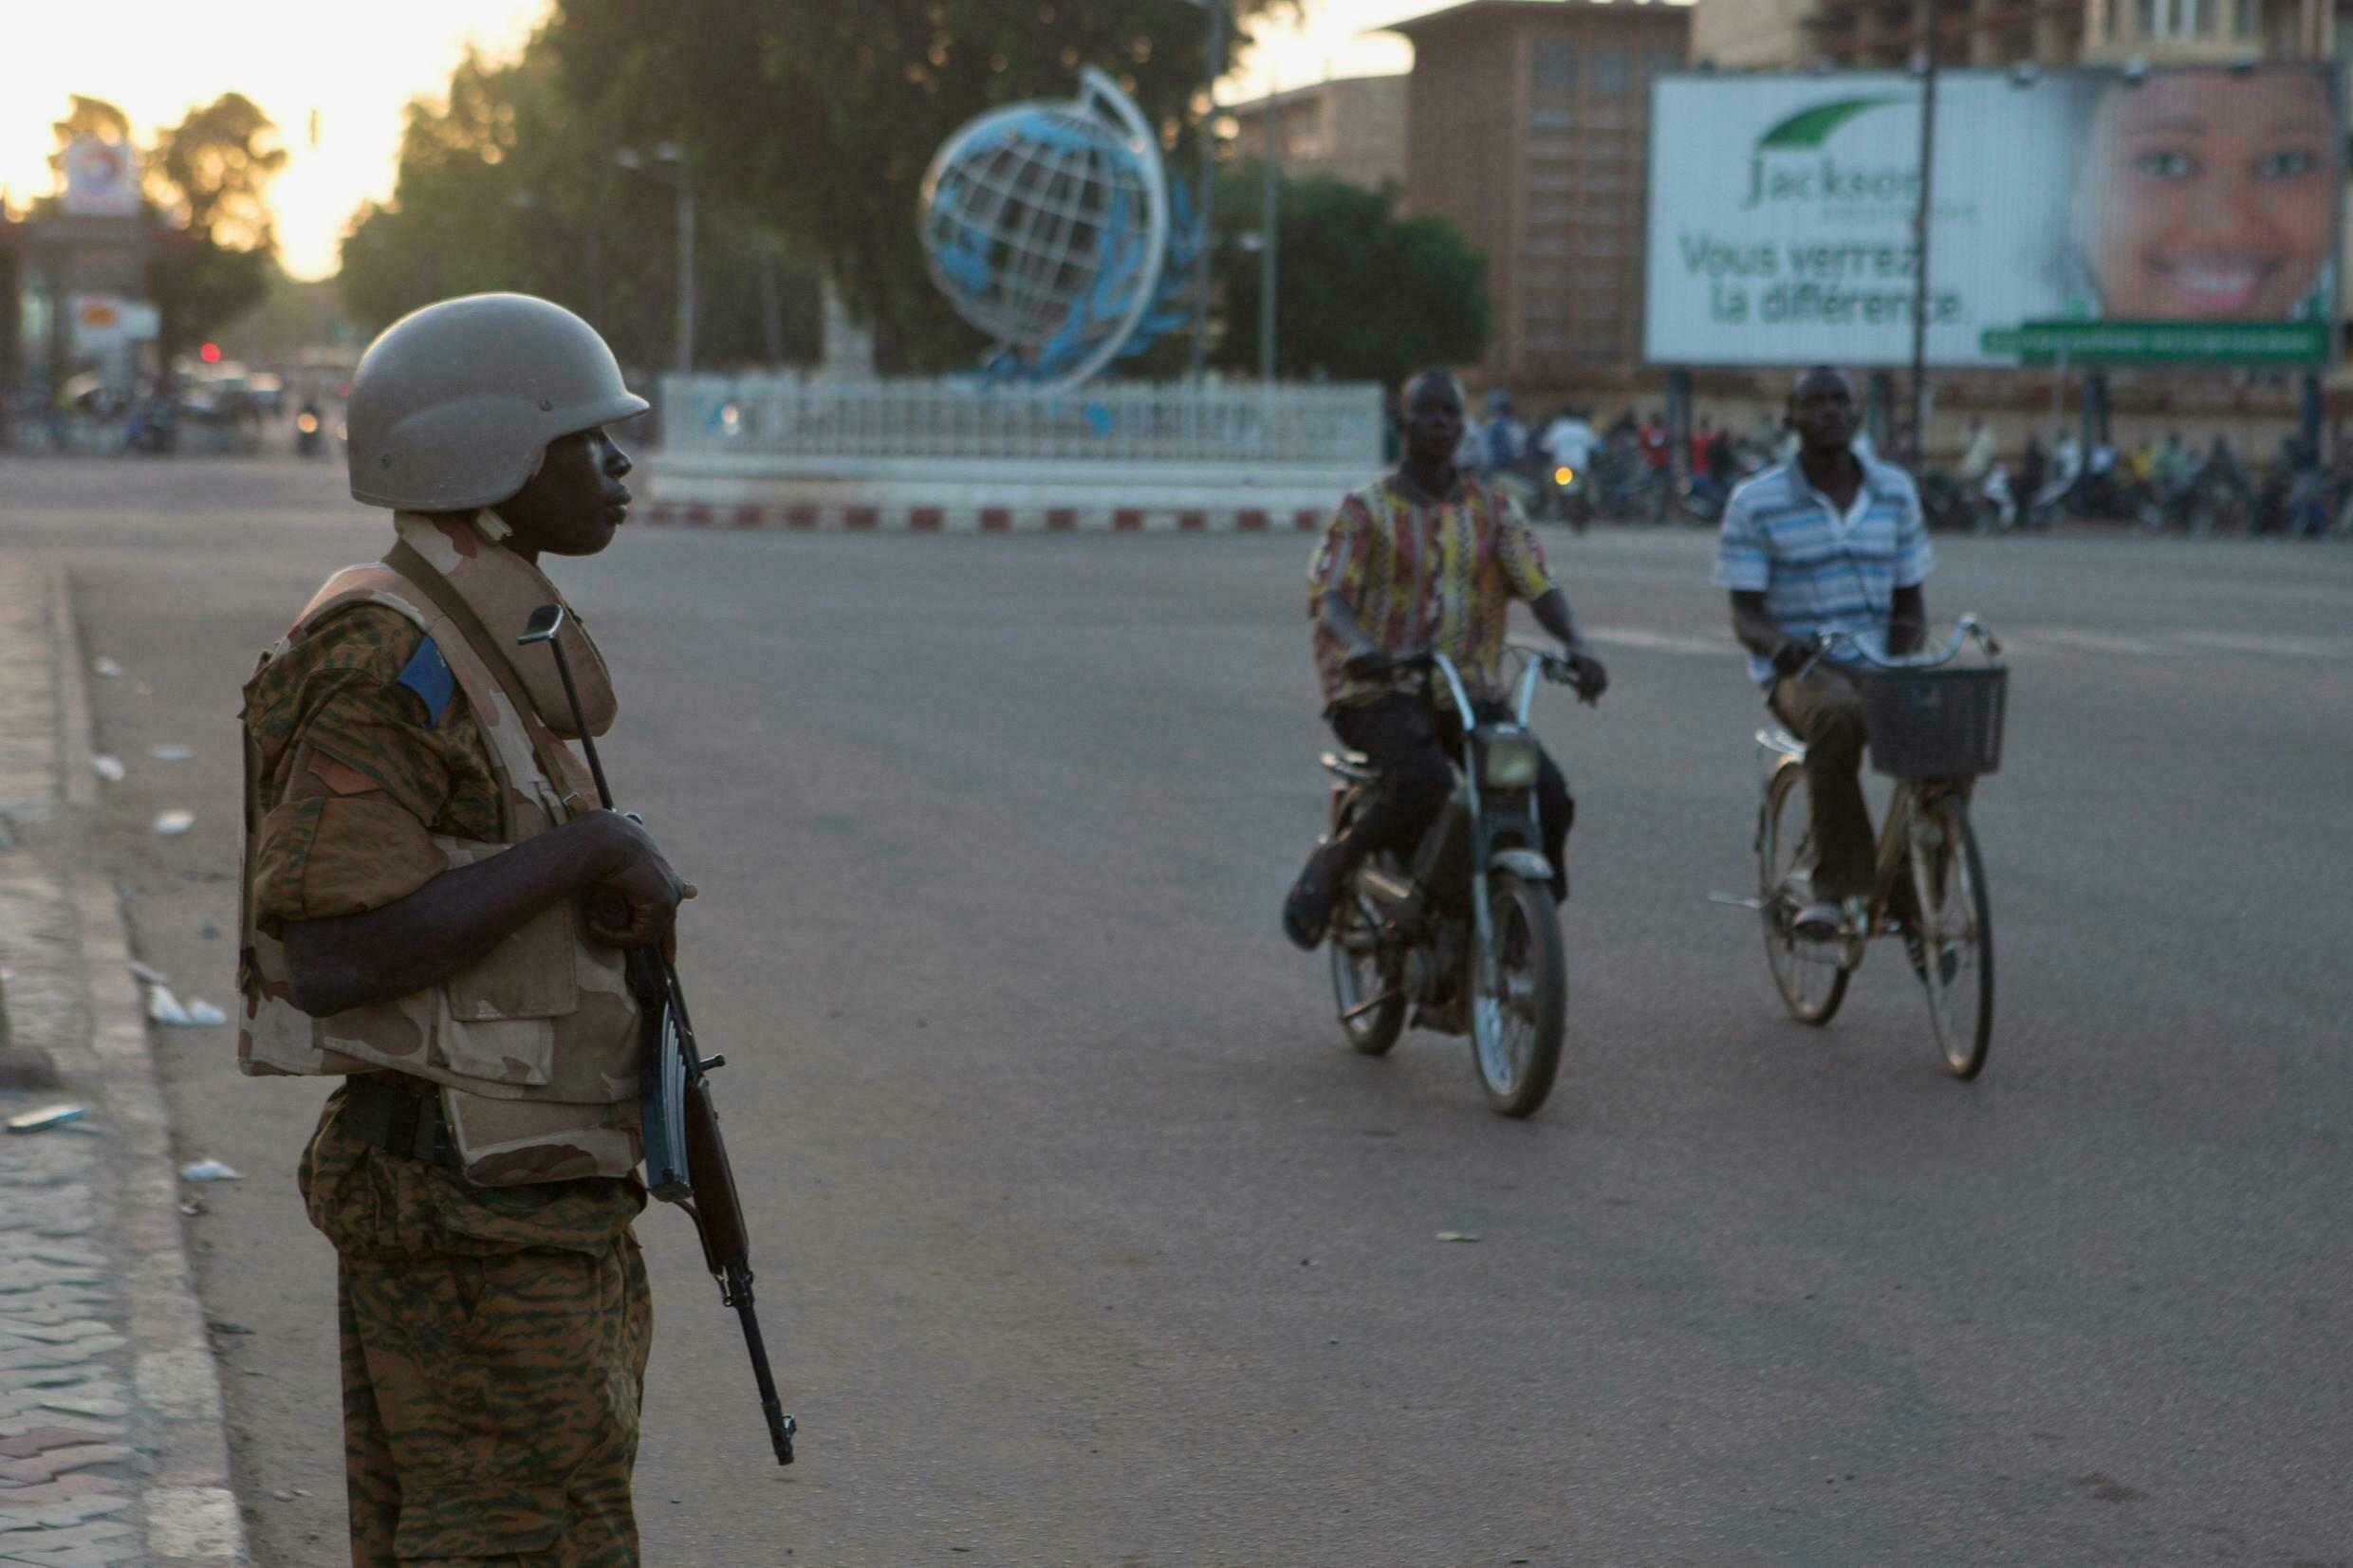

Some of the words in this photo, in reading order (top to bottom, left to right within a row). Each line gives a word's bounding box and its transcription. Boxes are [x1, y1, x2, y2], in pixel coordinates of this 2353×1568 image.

[1679, 233, 1779, 278] Vous
[1788, 239, 1926, 278] verrez
[1712, 283, 1748, 323] la
[1760, 282, 1961, 324] différene
